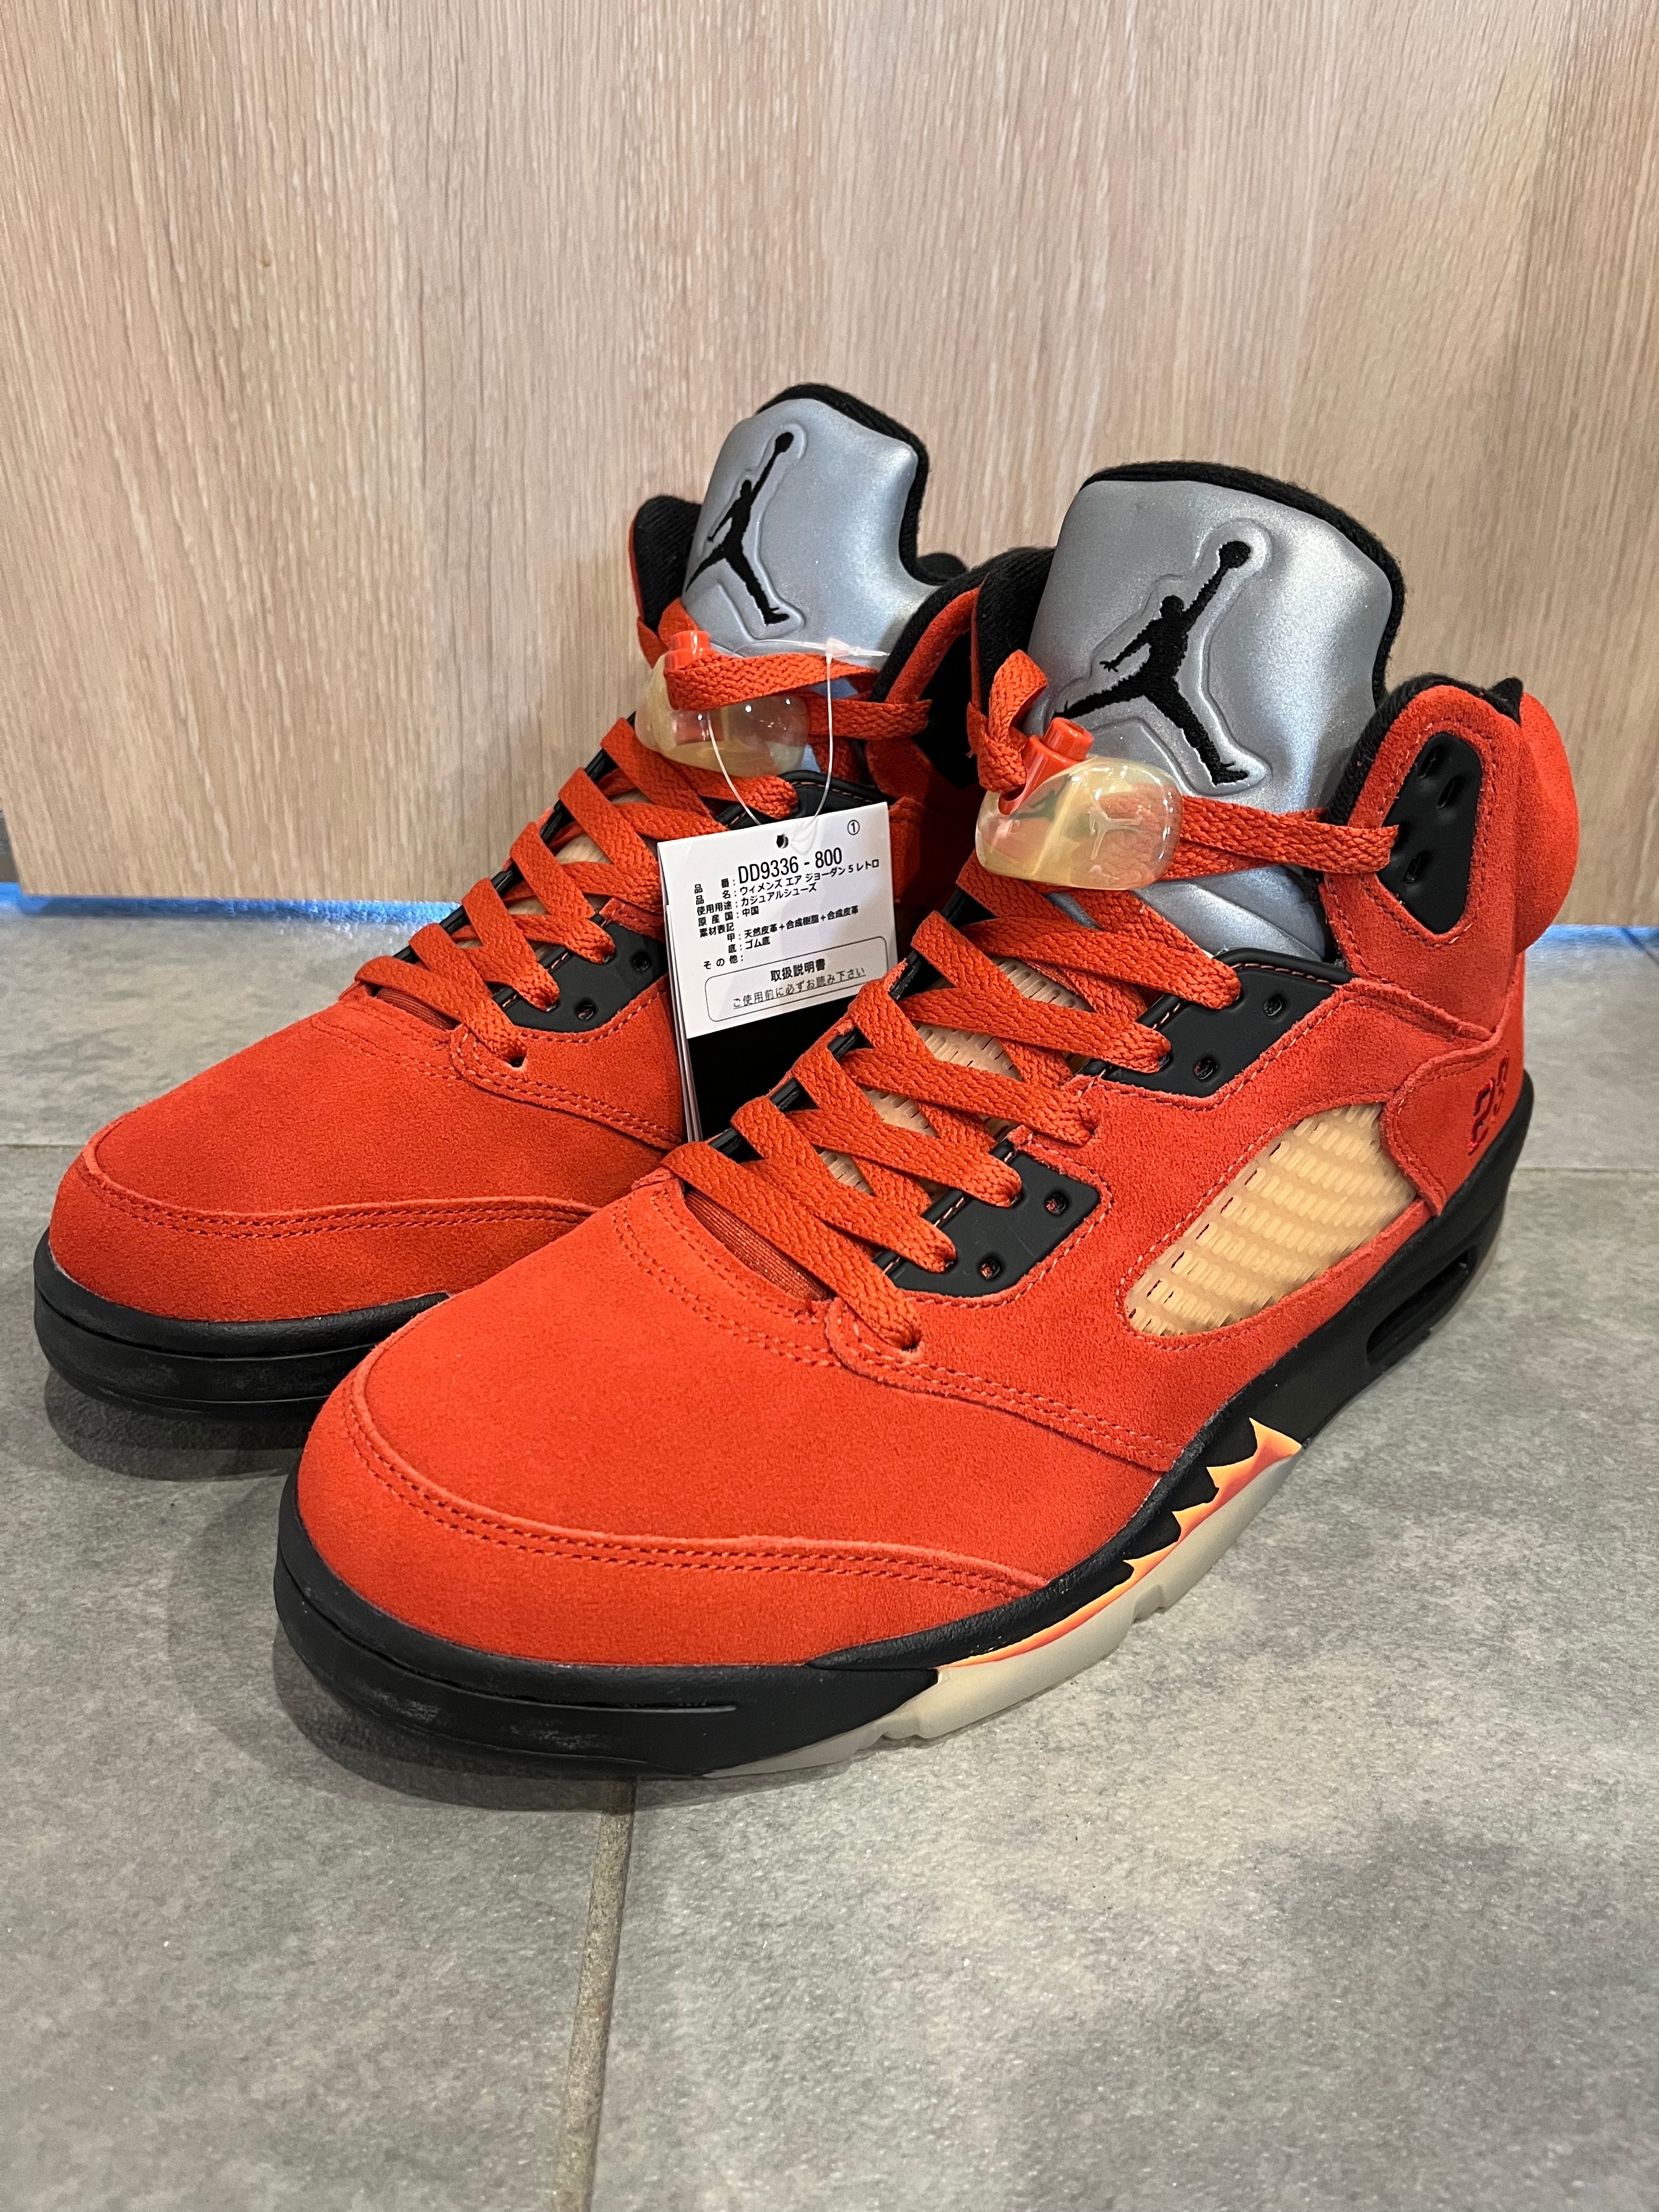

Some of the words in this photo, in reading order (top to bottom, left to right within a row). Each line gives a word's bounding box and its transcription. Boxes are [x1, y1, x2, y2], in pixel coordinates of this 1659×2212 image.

[699, 922, 734, 938] 素材表記
[771, 958, 826, 982] 取扱説明書
[733, 967, 865, 1008] ご使用前に必ずお読み下さい
